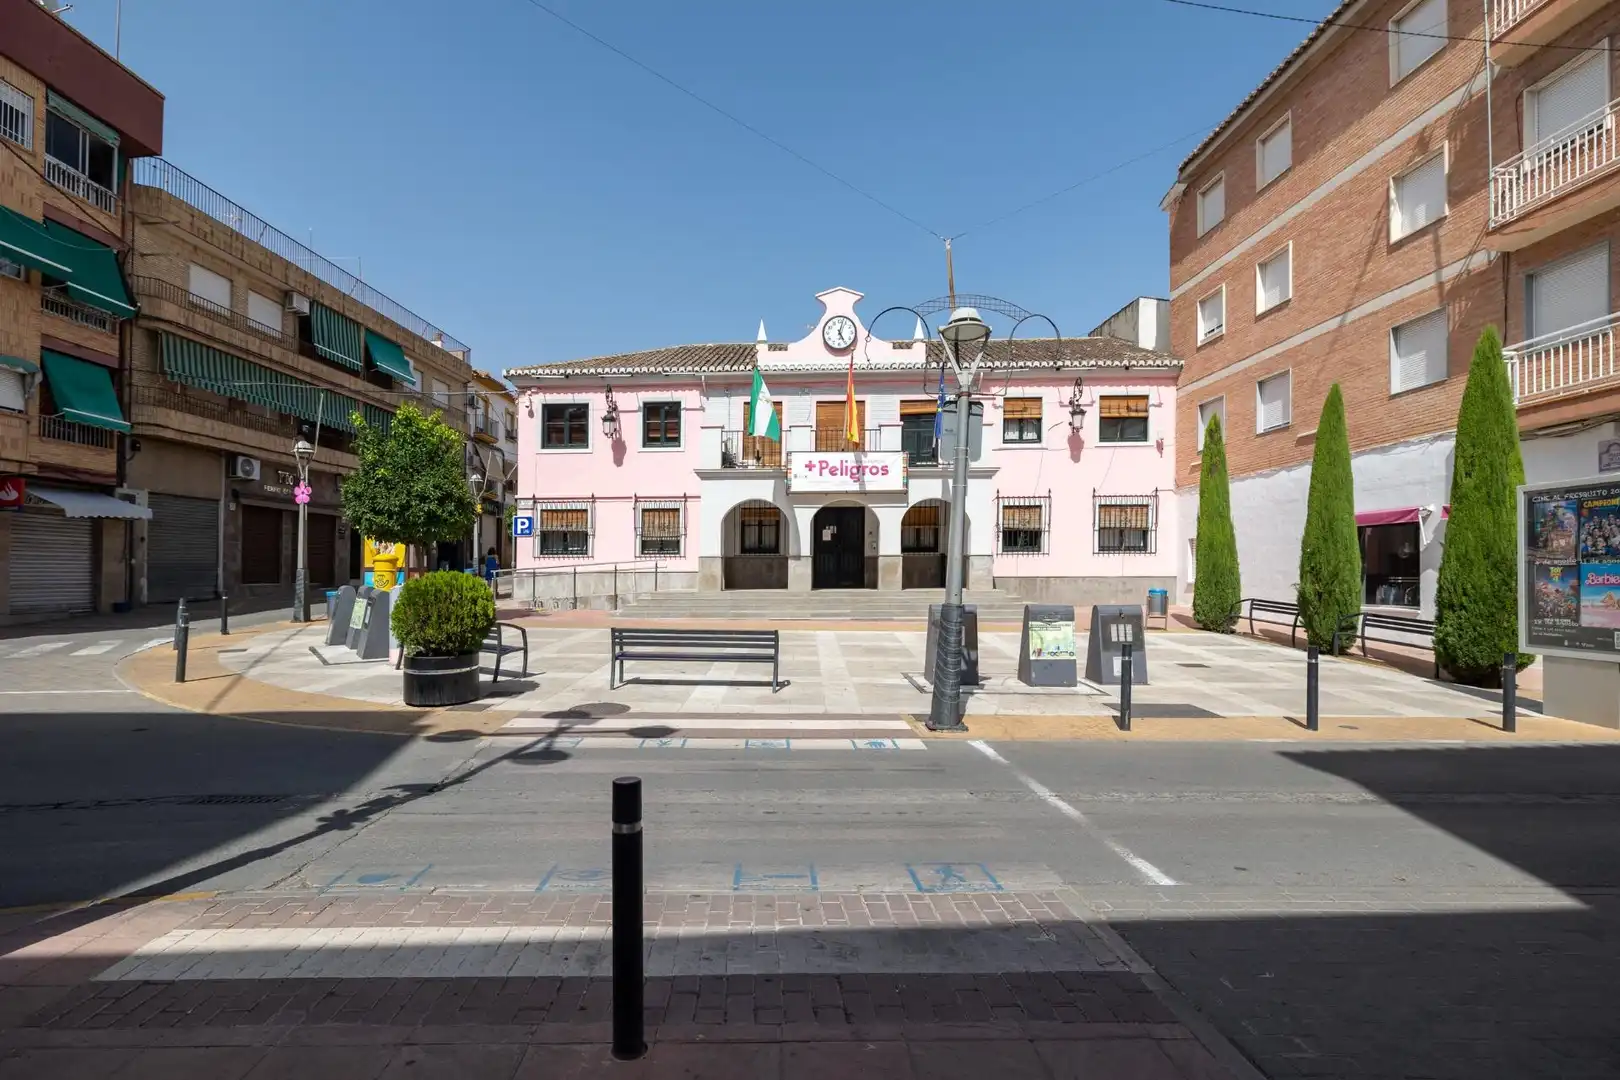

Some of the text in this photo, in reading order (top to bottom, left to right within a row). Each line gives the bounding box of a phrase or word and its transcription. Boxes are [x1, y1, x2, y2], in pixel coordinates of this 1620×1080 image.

[1564, 489, 1608, 500] FRESQUITO
[517, 518, 529, 534] P
[1585, 572, 1620, 585] Barbie
